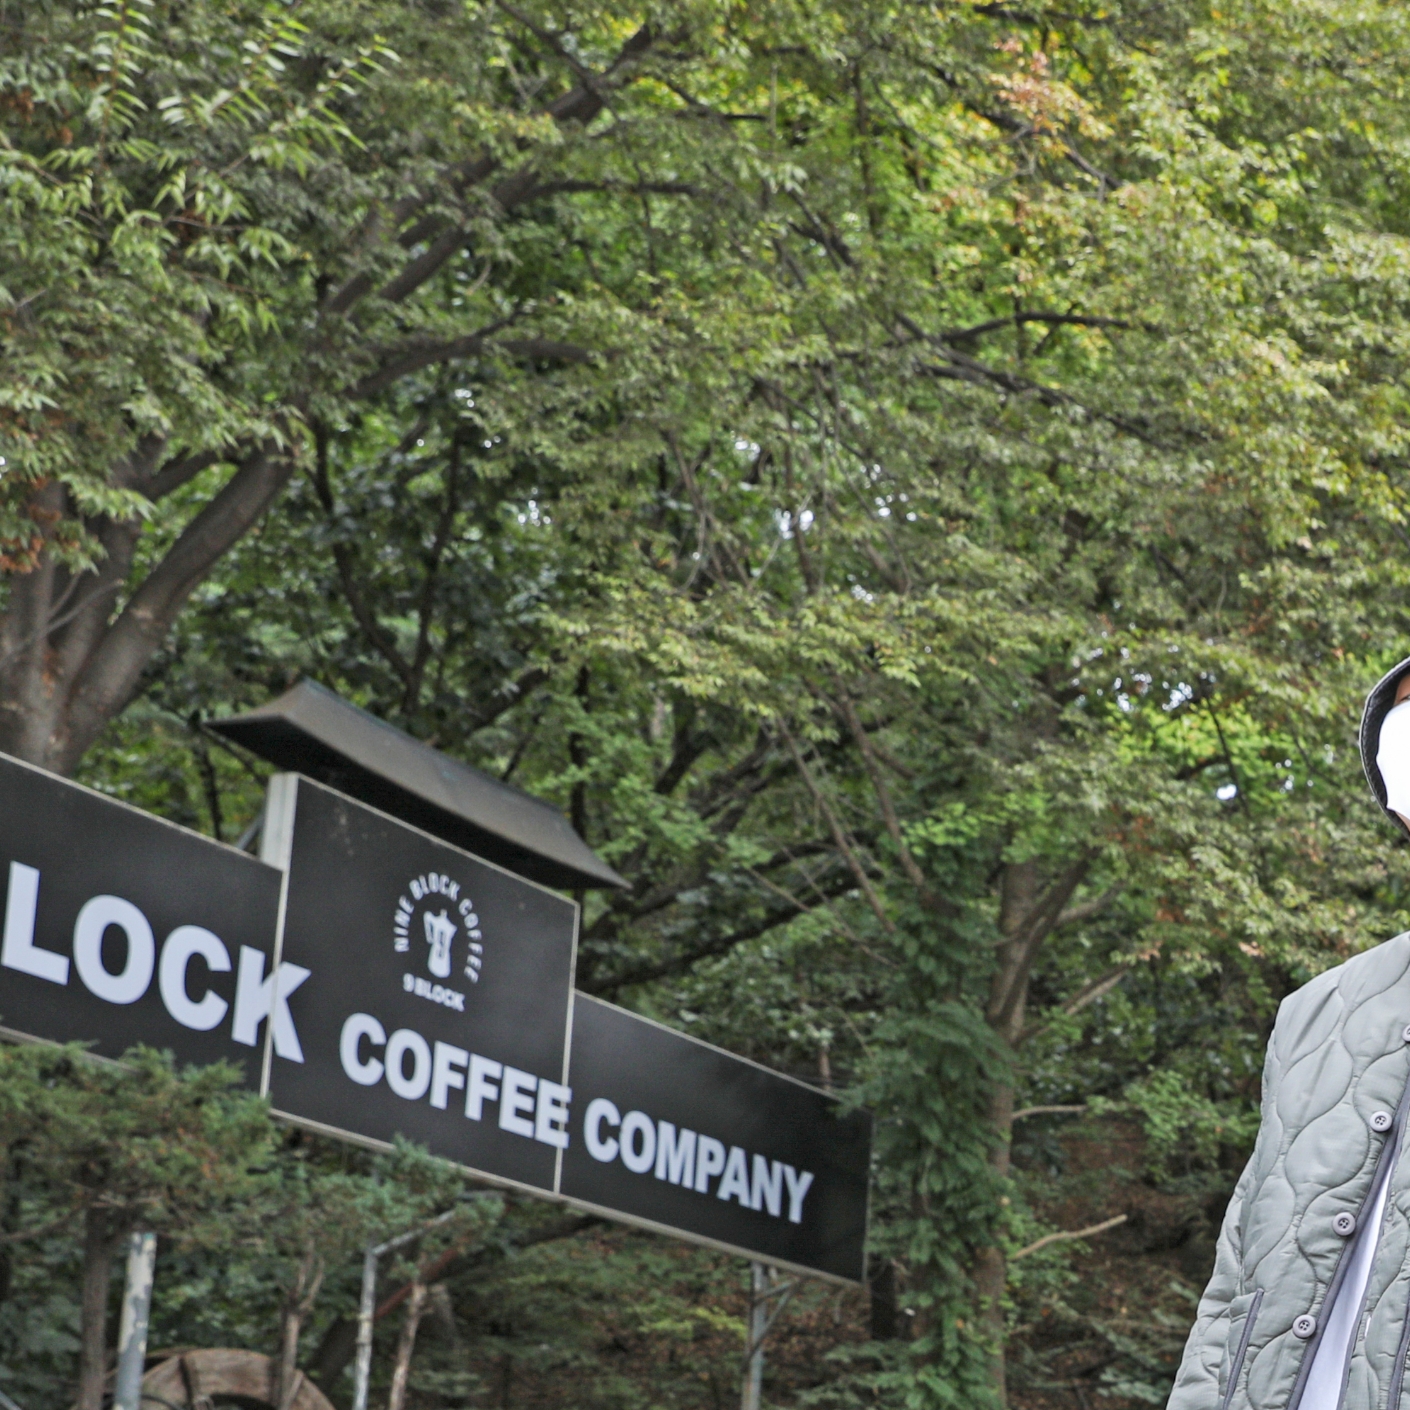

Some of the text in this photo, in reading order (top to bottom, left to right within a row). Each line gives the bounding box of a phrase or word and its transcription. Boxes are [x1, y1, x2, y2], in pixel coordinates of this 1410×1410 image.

[393, 894, 415, 953] NINE
[409, 871, 461, 902] BLOCK
[458, 897, 483, 984] COFFEE
[339, 1012, 572, 1149] COFFEE
[583, 1098, 815, 1224] COMPANY
